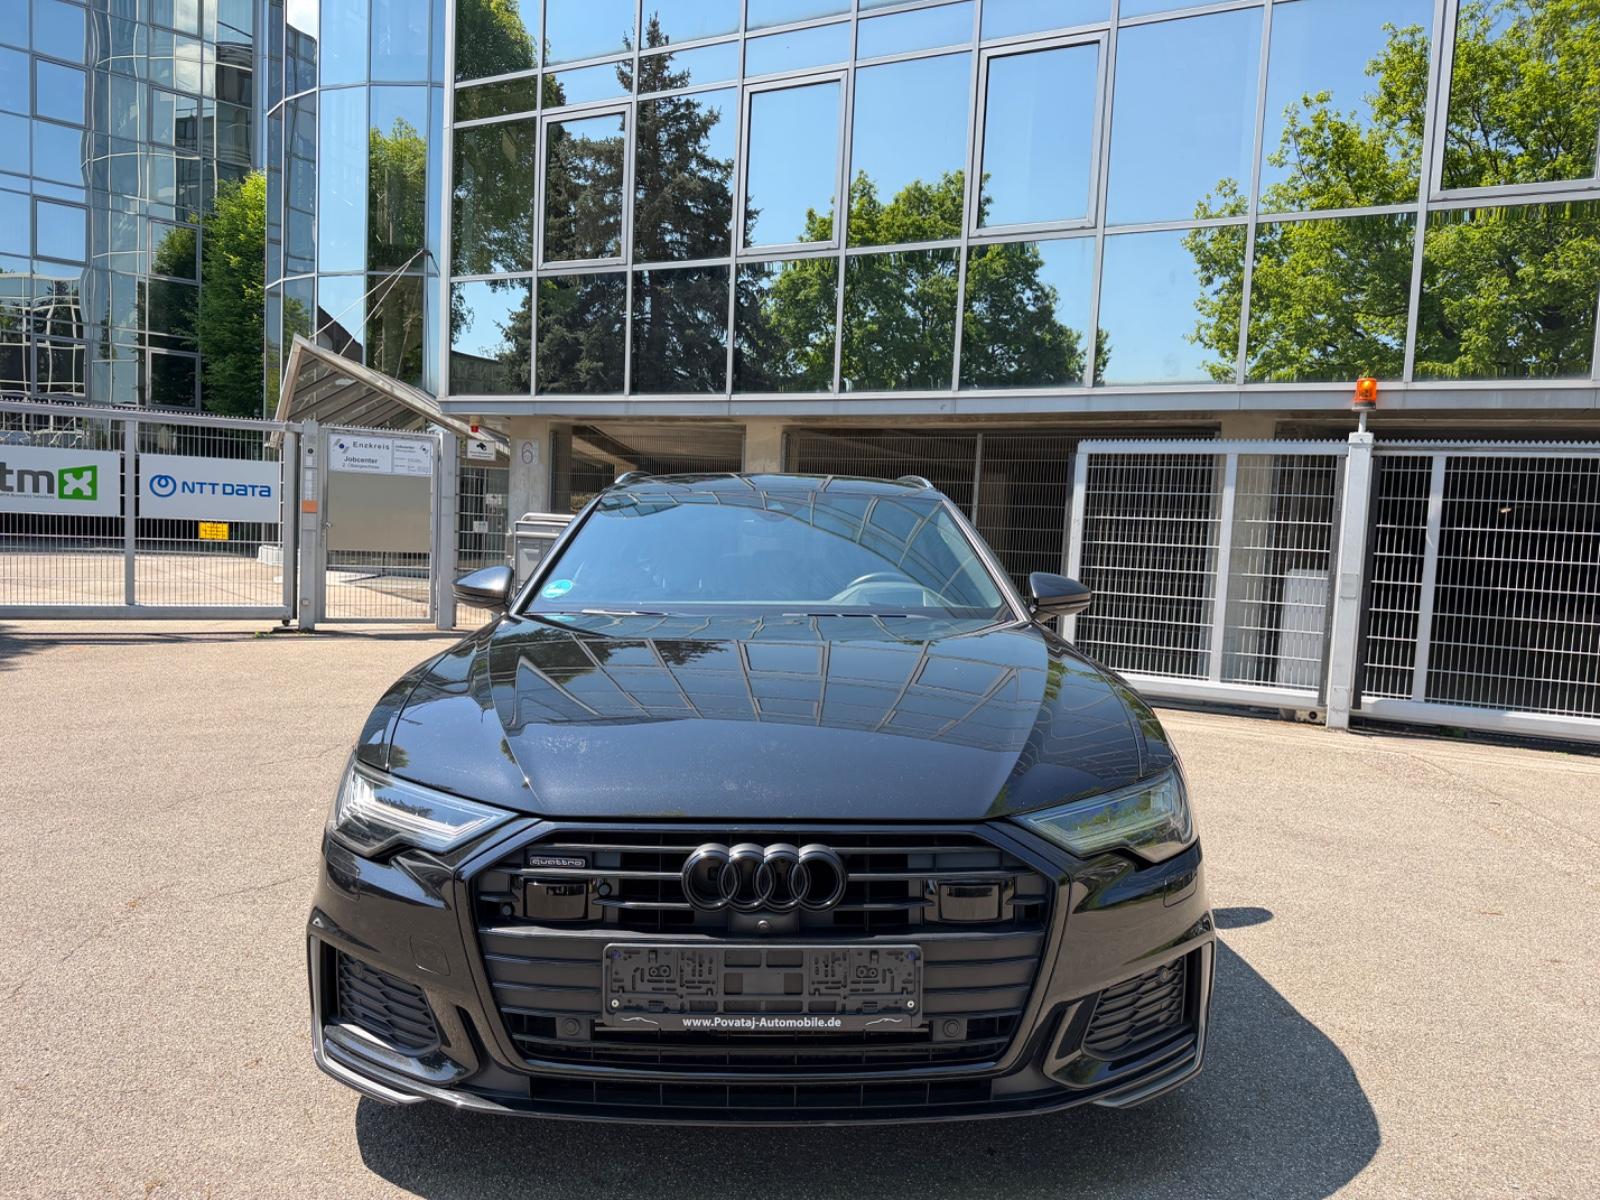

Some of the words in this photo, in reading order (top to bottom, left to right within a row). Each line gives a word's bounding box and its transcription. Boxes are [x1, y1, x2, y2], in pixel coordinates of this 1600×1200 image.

[352, 441, 390, 450] Enzkreis
[522, 441, 533, 464] 6
[344, 456, 378, 464] Jobcenter
[181, 481, 219, 495] NTT
[531, 858, 583, 867] quattro
[682, 1016, 842, 1030] www.Povataj-Automobile.de
